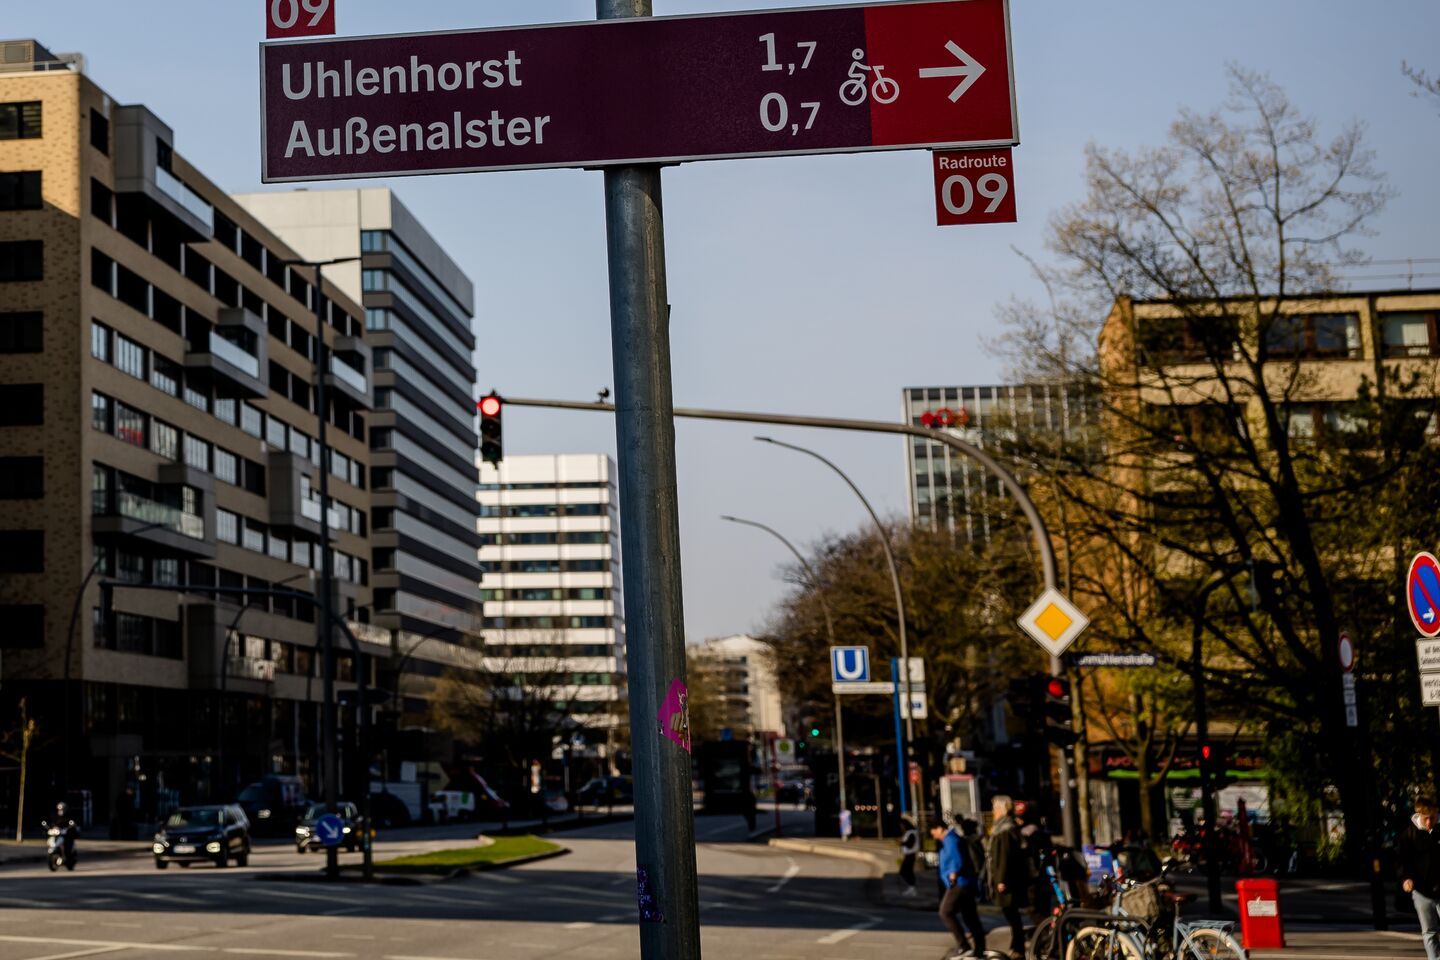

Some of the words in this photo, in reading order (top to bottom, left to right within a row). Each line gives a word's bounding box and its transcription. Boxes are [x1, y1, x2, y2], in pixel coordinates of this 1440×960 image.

[282, 50, 523, 101] Uhlenhorst
[758, 32, 817, 76] 1,7
[283, 110, 551, 158] Außenalster
[759, 92, 821, 136] 0,7
[938, 154, 1007, 170] Radroute
[941, 172, 1009, 215] 09
[836, 650, 864, 680] U
